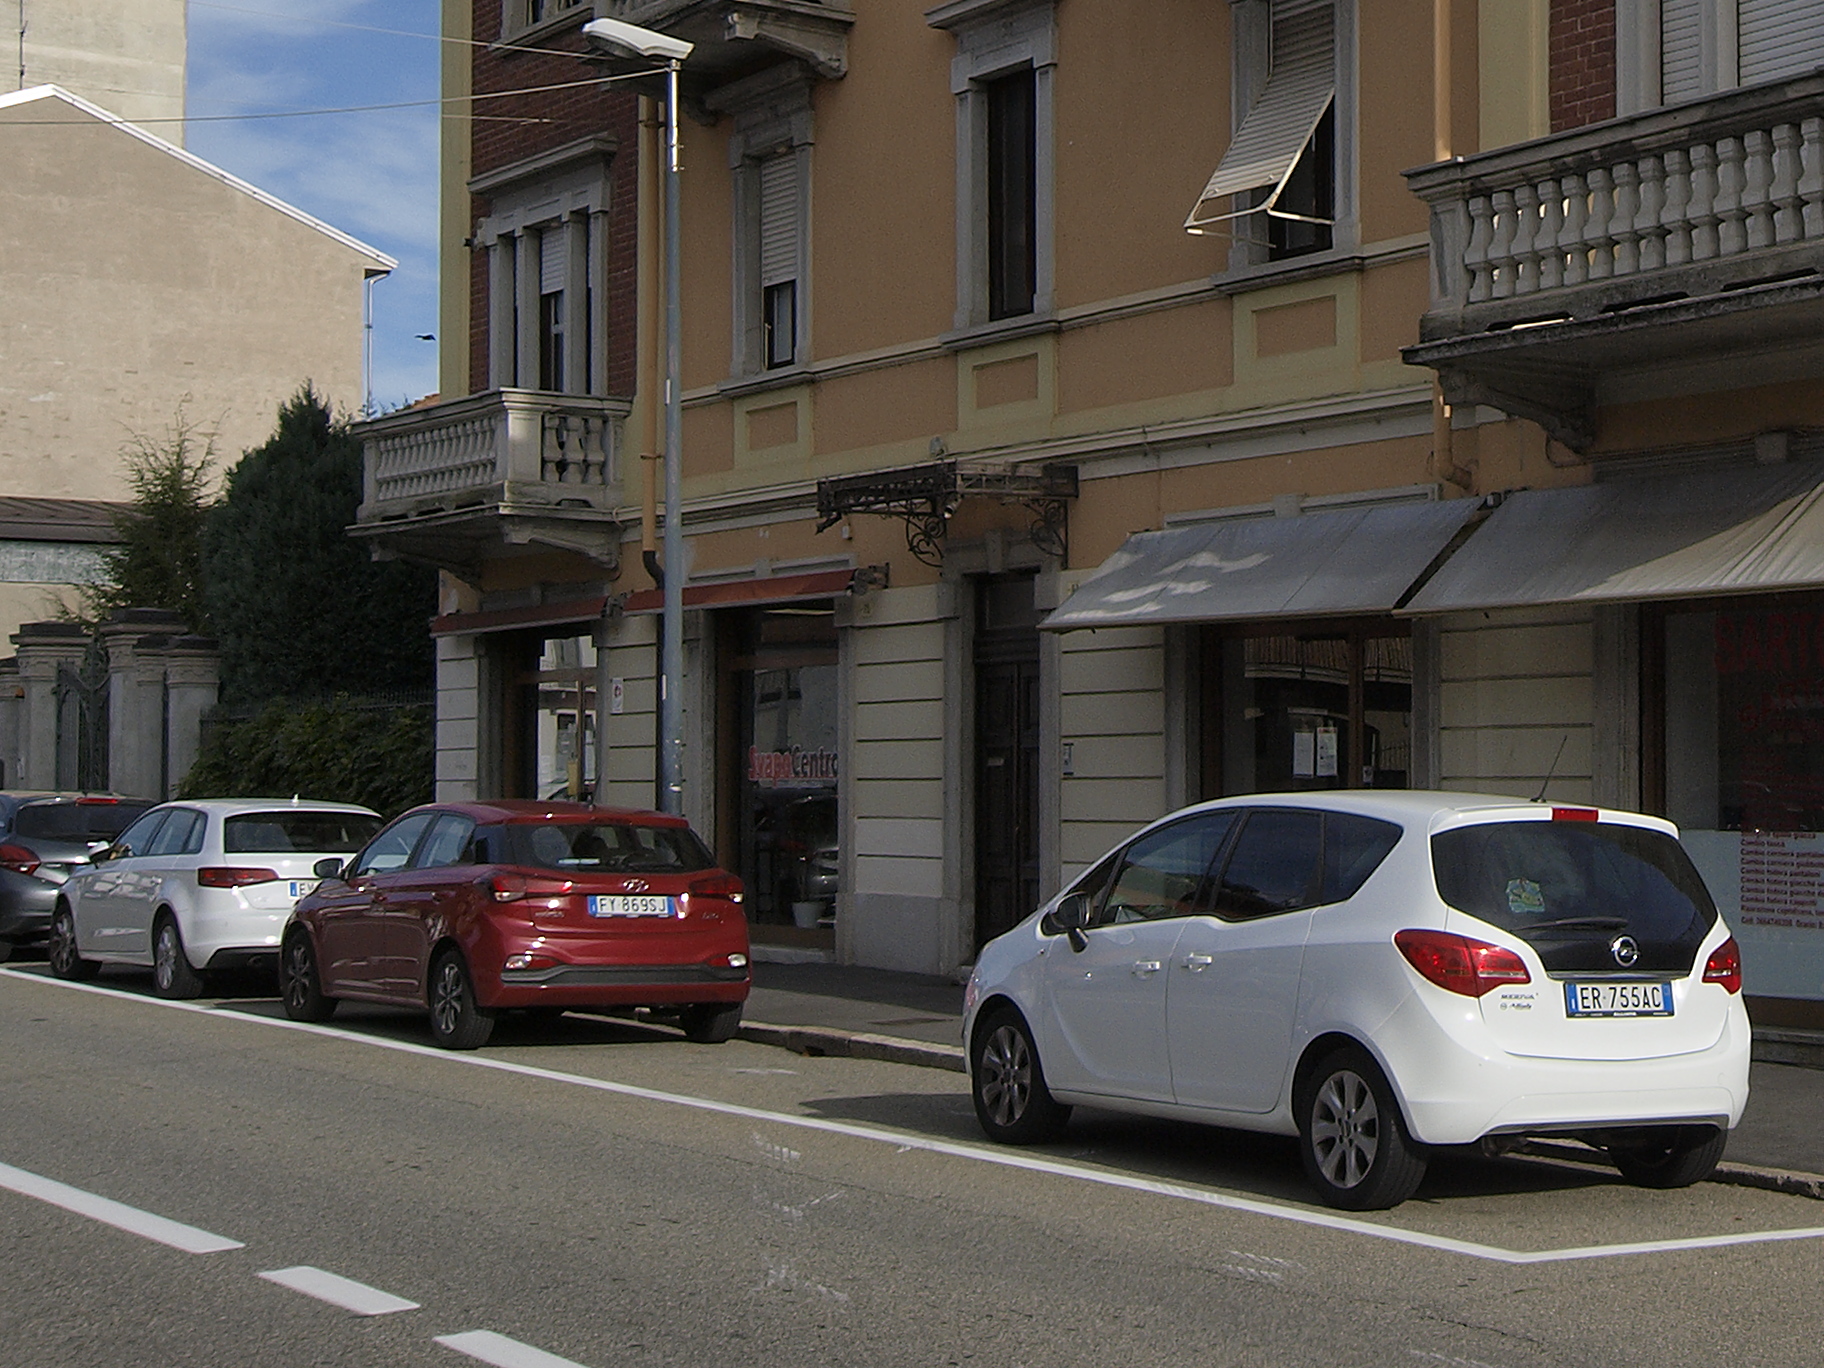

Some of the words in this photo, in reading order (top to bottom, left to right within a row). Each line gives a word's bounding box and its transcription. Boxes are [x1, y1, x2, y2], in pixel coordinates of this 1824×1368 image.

[599, 898, 615, 912] FY
[622, 898, 667, 912] 869SJ
[1580, 986, 1601, 1010] ER
[1609, 985, 1662, 1009] 755AC
